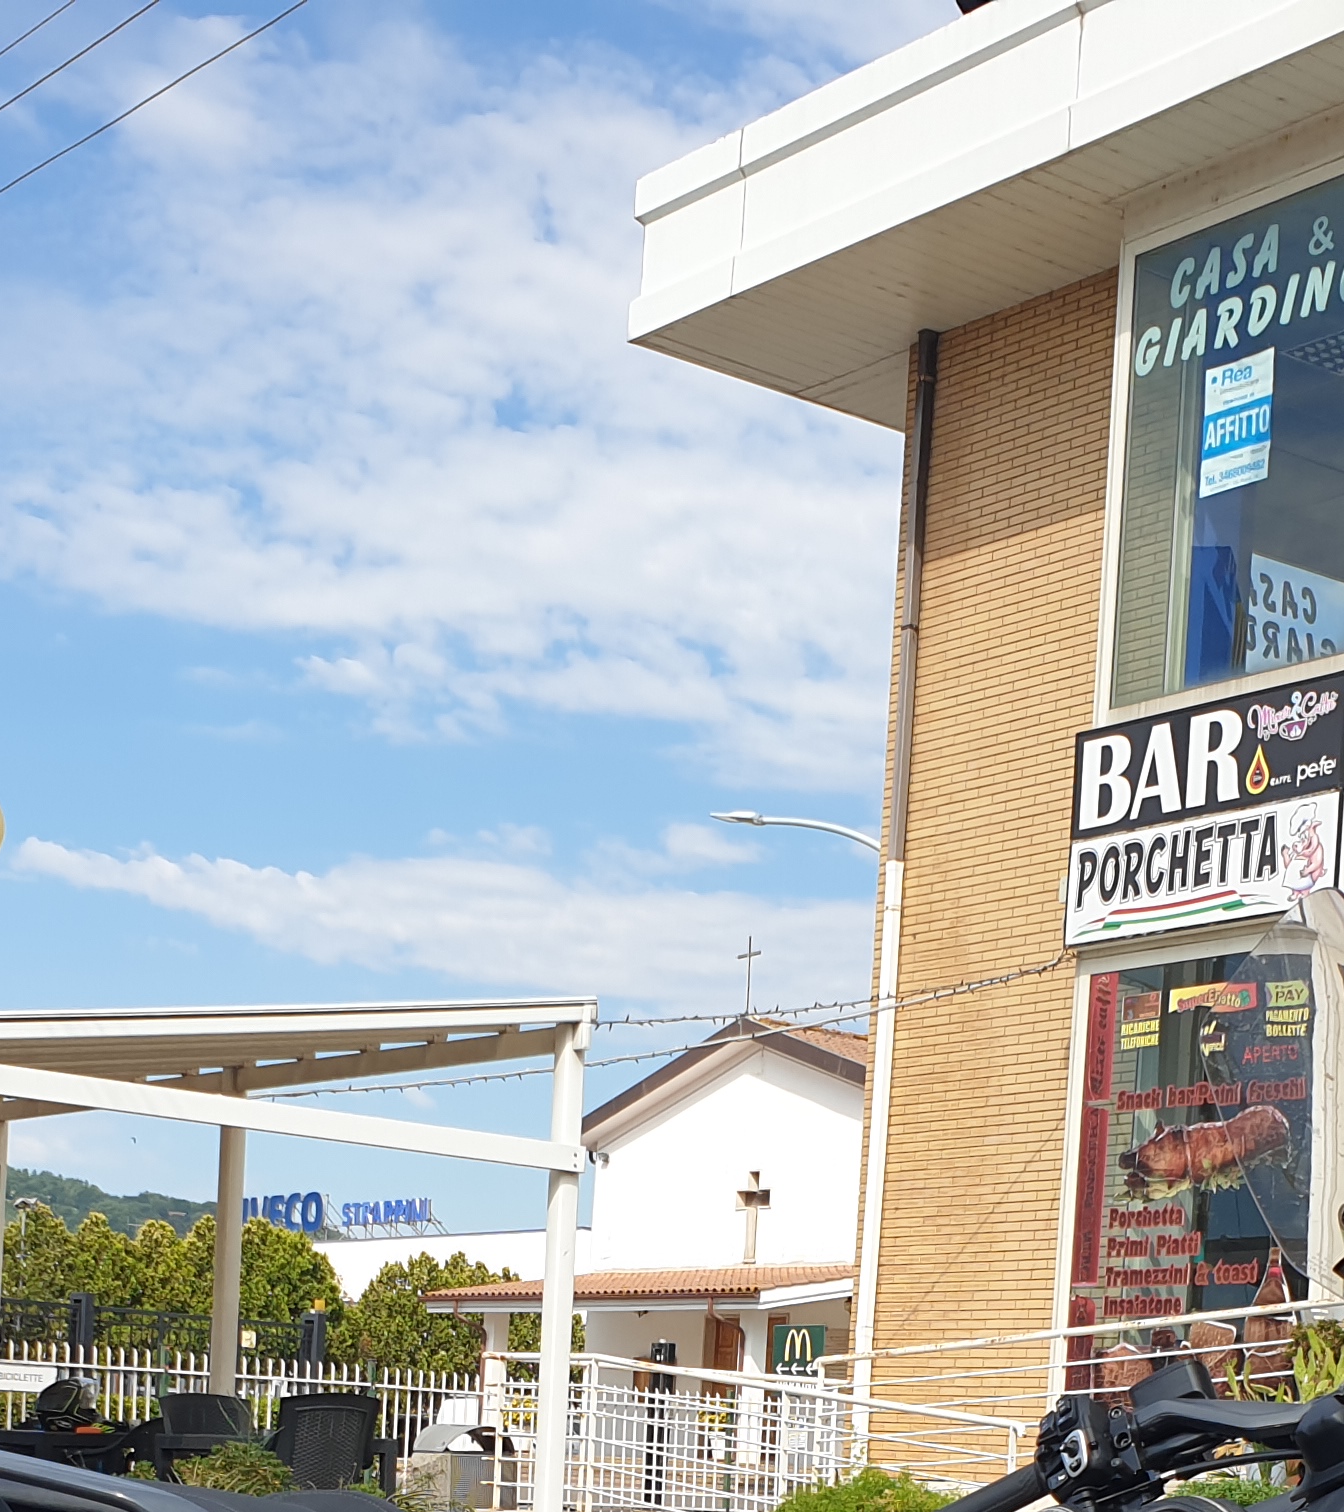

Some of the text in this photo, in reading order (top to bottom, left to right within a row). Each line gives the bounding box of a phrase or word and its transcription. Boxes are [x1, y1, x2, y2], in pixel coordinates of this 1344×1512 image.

[1170, 215, 1336, 309] CASA &
[1221, 365, 1253, 387] Rea
[1204, 404, 1270, 451] AFFITTO
[1078, 709, 1243, 831] BAR
[1075, 812, 1279, 912] PORCHETTA
[1275, 988, 1304, 1003] PAY
[1120, 1033, 1159, 1050] TELEFONICHE
[1242, 1044, 1299, 1064] APERTO
[1116, 1087, 1163, 1112] Snack
[243, 1191, 432, 1233] IVECO STRAPPINI
[1108, 1204, 1184, 1230] Porchetta
[1107, 1235, 1150, 1258] Primi
[1154, 1231, 1201, 1258] Piatti
[1105, 1257, 1259, 1289] Tramezzini & toast
[1102, 1294, 1183, 1317] Insalatone
